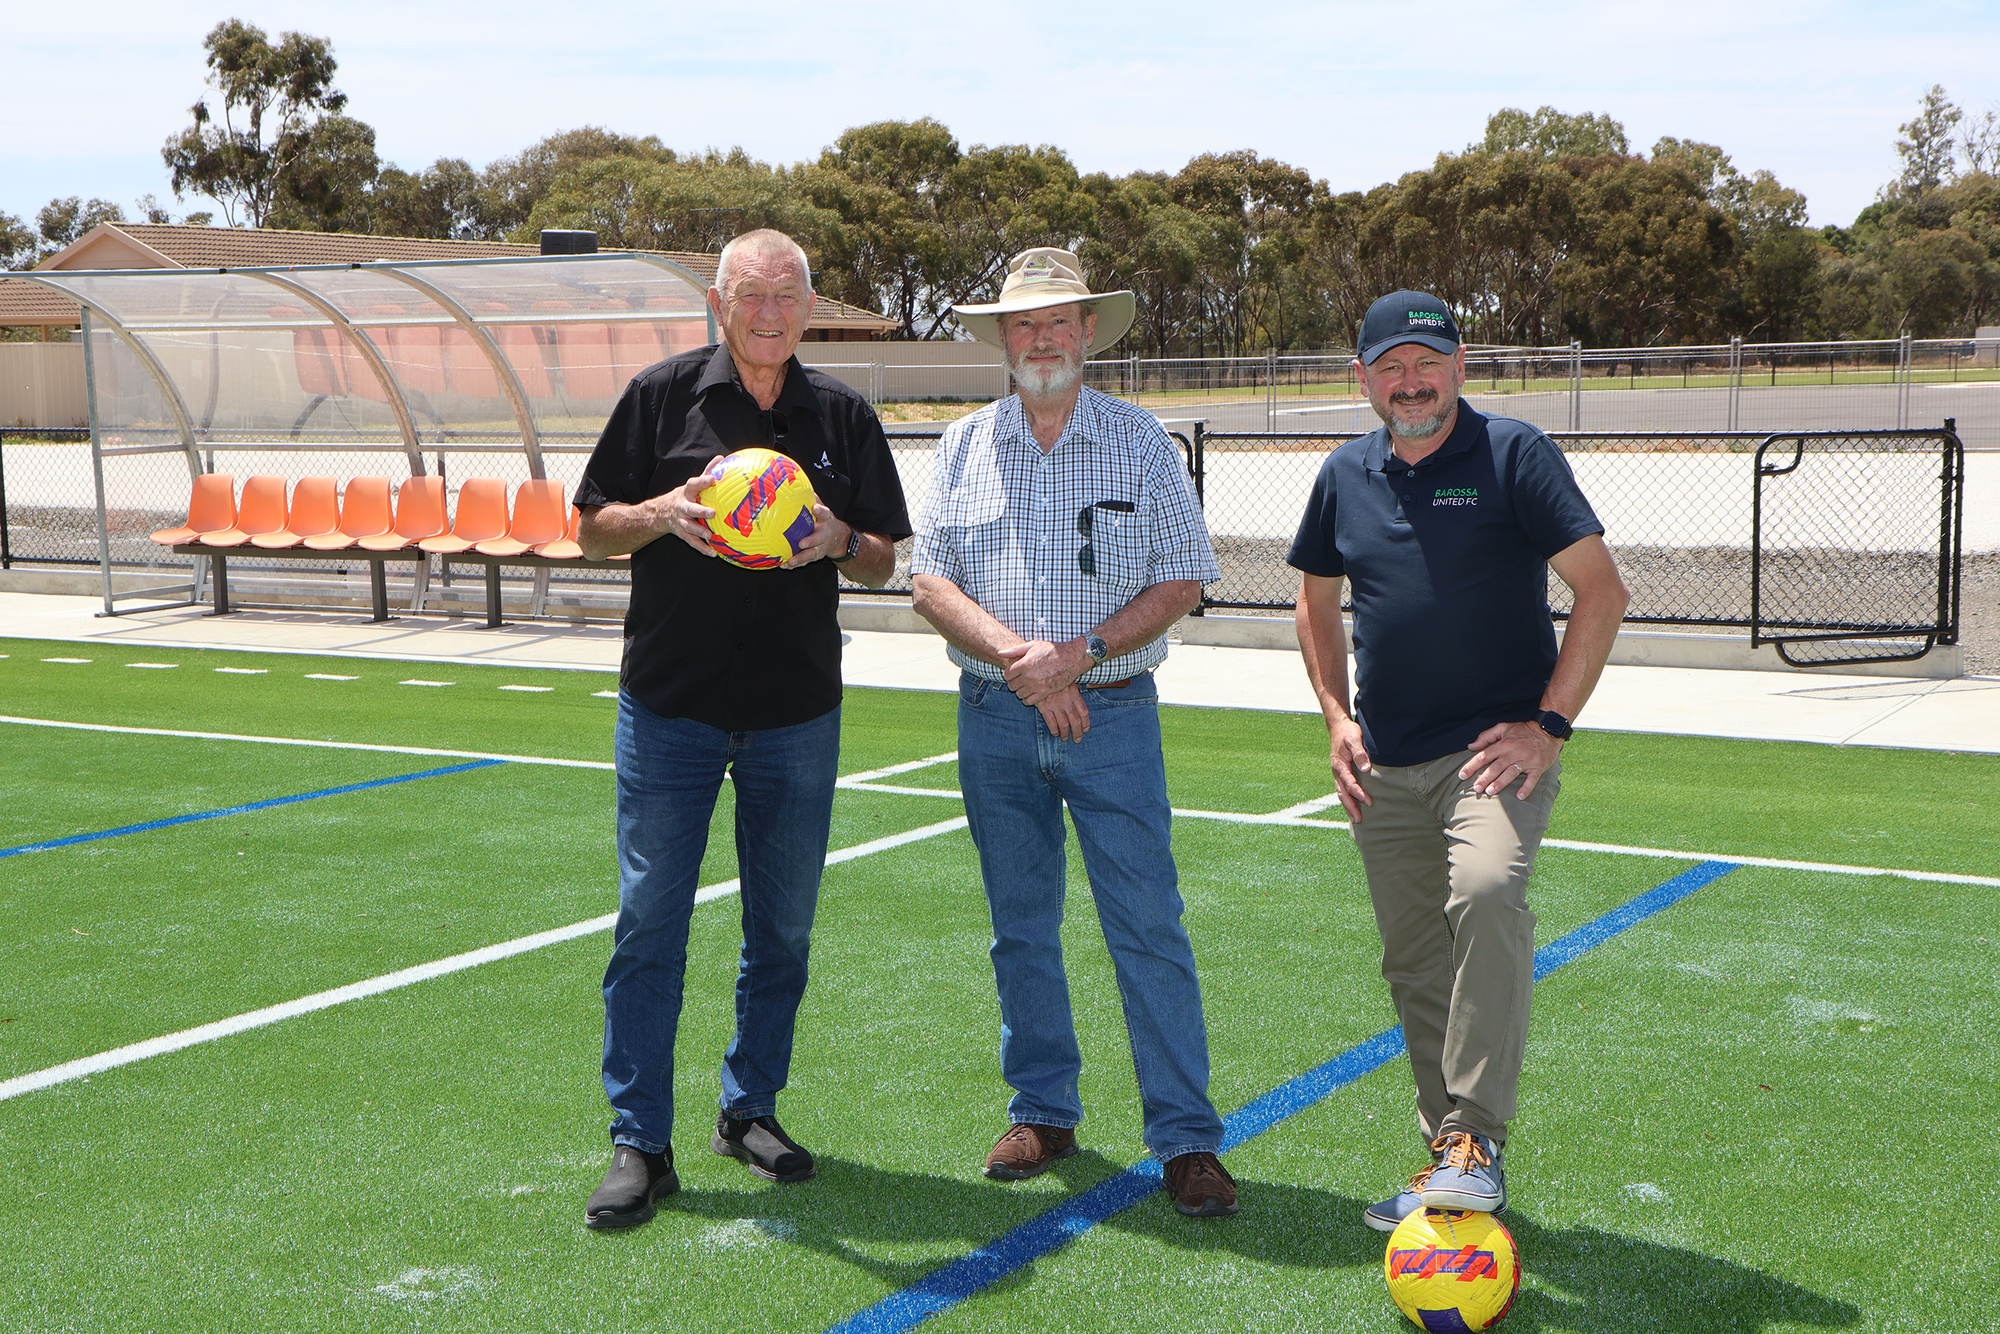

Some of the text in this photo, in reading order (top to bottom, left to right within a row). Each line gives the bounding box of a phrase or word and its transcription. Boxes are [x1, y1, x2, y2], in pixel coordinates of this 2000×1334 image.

[1408, 311, 1444, 320] BAROSSA
[1409, 318, 1446, 329] UNITED FC
[1434, 488, 1478, 497] BAROSSA
[1432, 497, 1478, 507] UNITED FC
